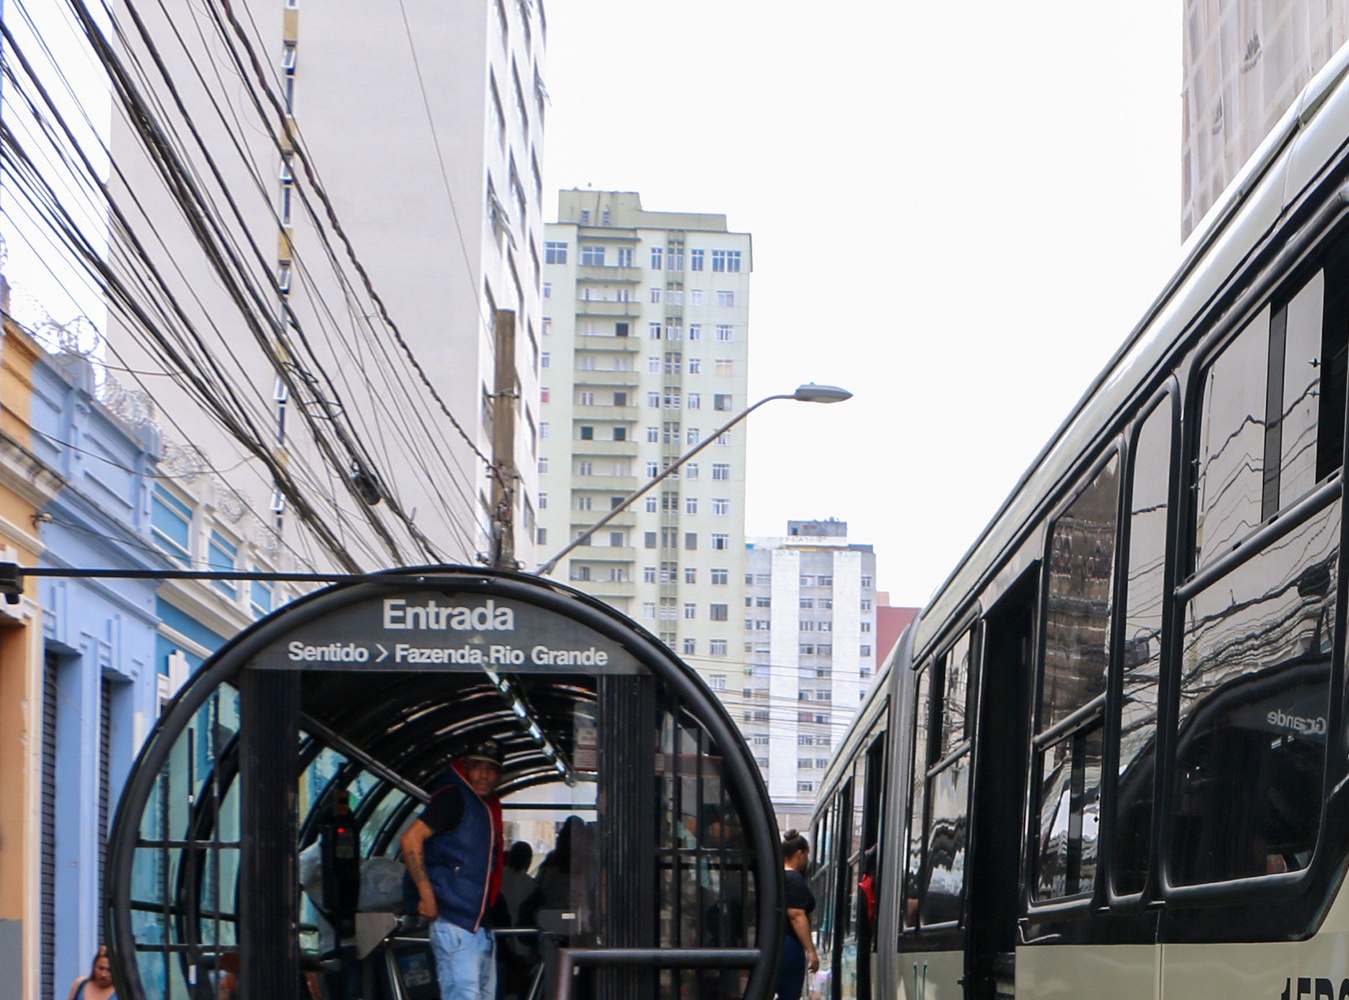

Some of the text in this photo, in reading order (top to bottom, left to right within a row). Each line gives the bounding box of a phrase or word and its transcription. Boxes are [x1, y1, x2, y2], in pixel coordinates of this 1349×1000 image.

[382, 599, 515, 631] Entrada
[288, 642, 608, 667] Sentido Fazenda Rio Grande
